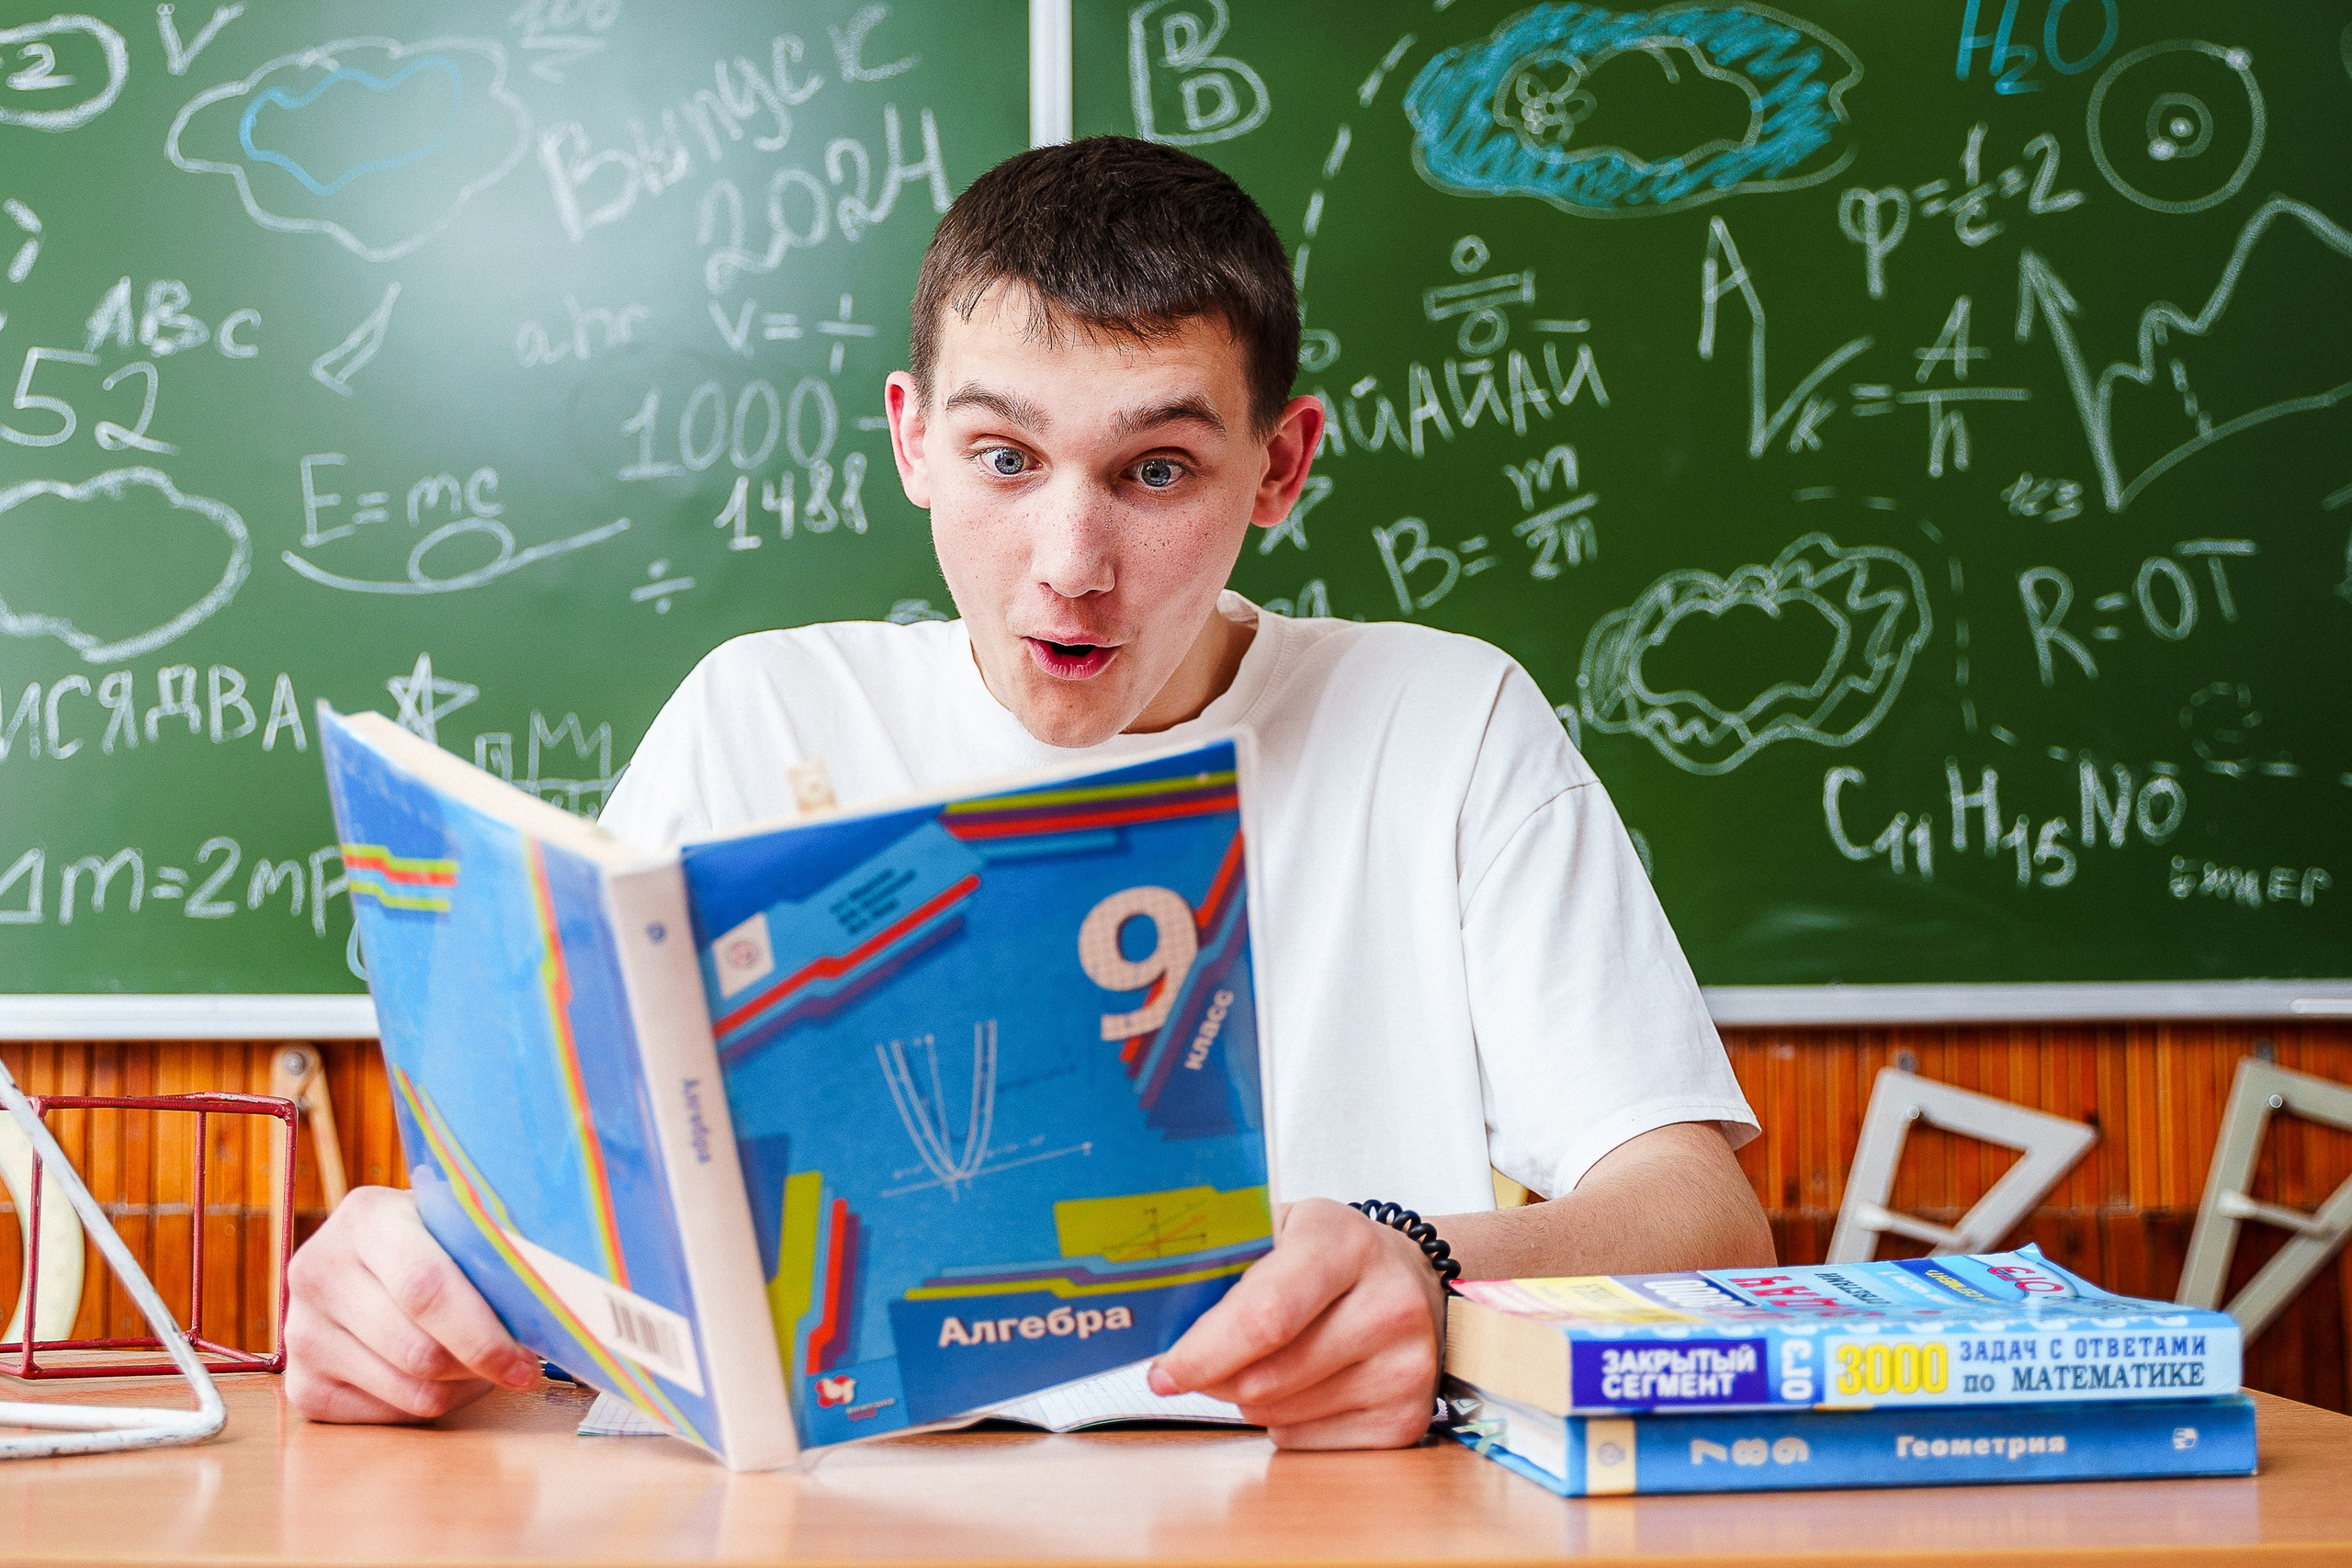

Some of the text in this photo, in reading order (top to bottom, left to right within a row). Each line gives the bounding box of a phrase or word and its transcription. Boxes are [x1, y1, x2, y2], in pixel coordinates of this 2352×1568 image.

[1078, 886, 1199, 1043] 9
[1182, 988, 1235, 1071] класс
[1987, 1266, 2065, 1292] ОГЭ
[937, 1304, 1135, 1349] Алгебра
[1600, 1346, 1758, 1376] ЗАКРЫТЫЙ
[1959, 1335, 2207, 1363] ЗАДАЧ С ОТВЕТАМИ
[1780, 1338, 1814, 1401] ОГЭ
[1836, 1342, 1949, 1395] 3000
[1962, 1360, 2205, 1393] по МАТЕМАТИКЕ
[1600, 1371, 1736, 1400] СЕГМЕНТ
[1895, 1435, 2066, 1461] Геометрия
